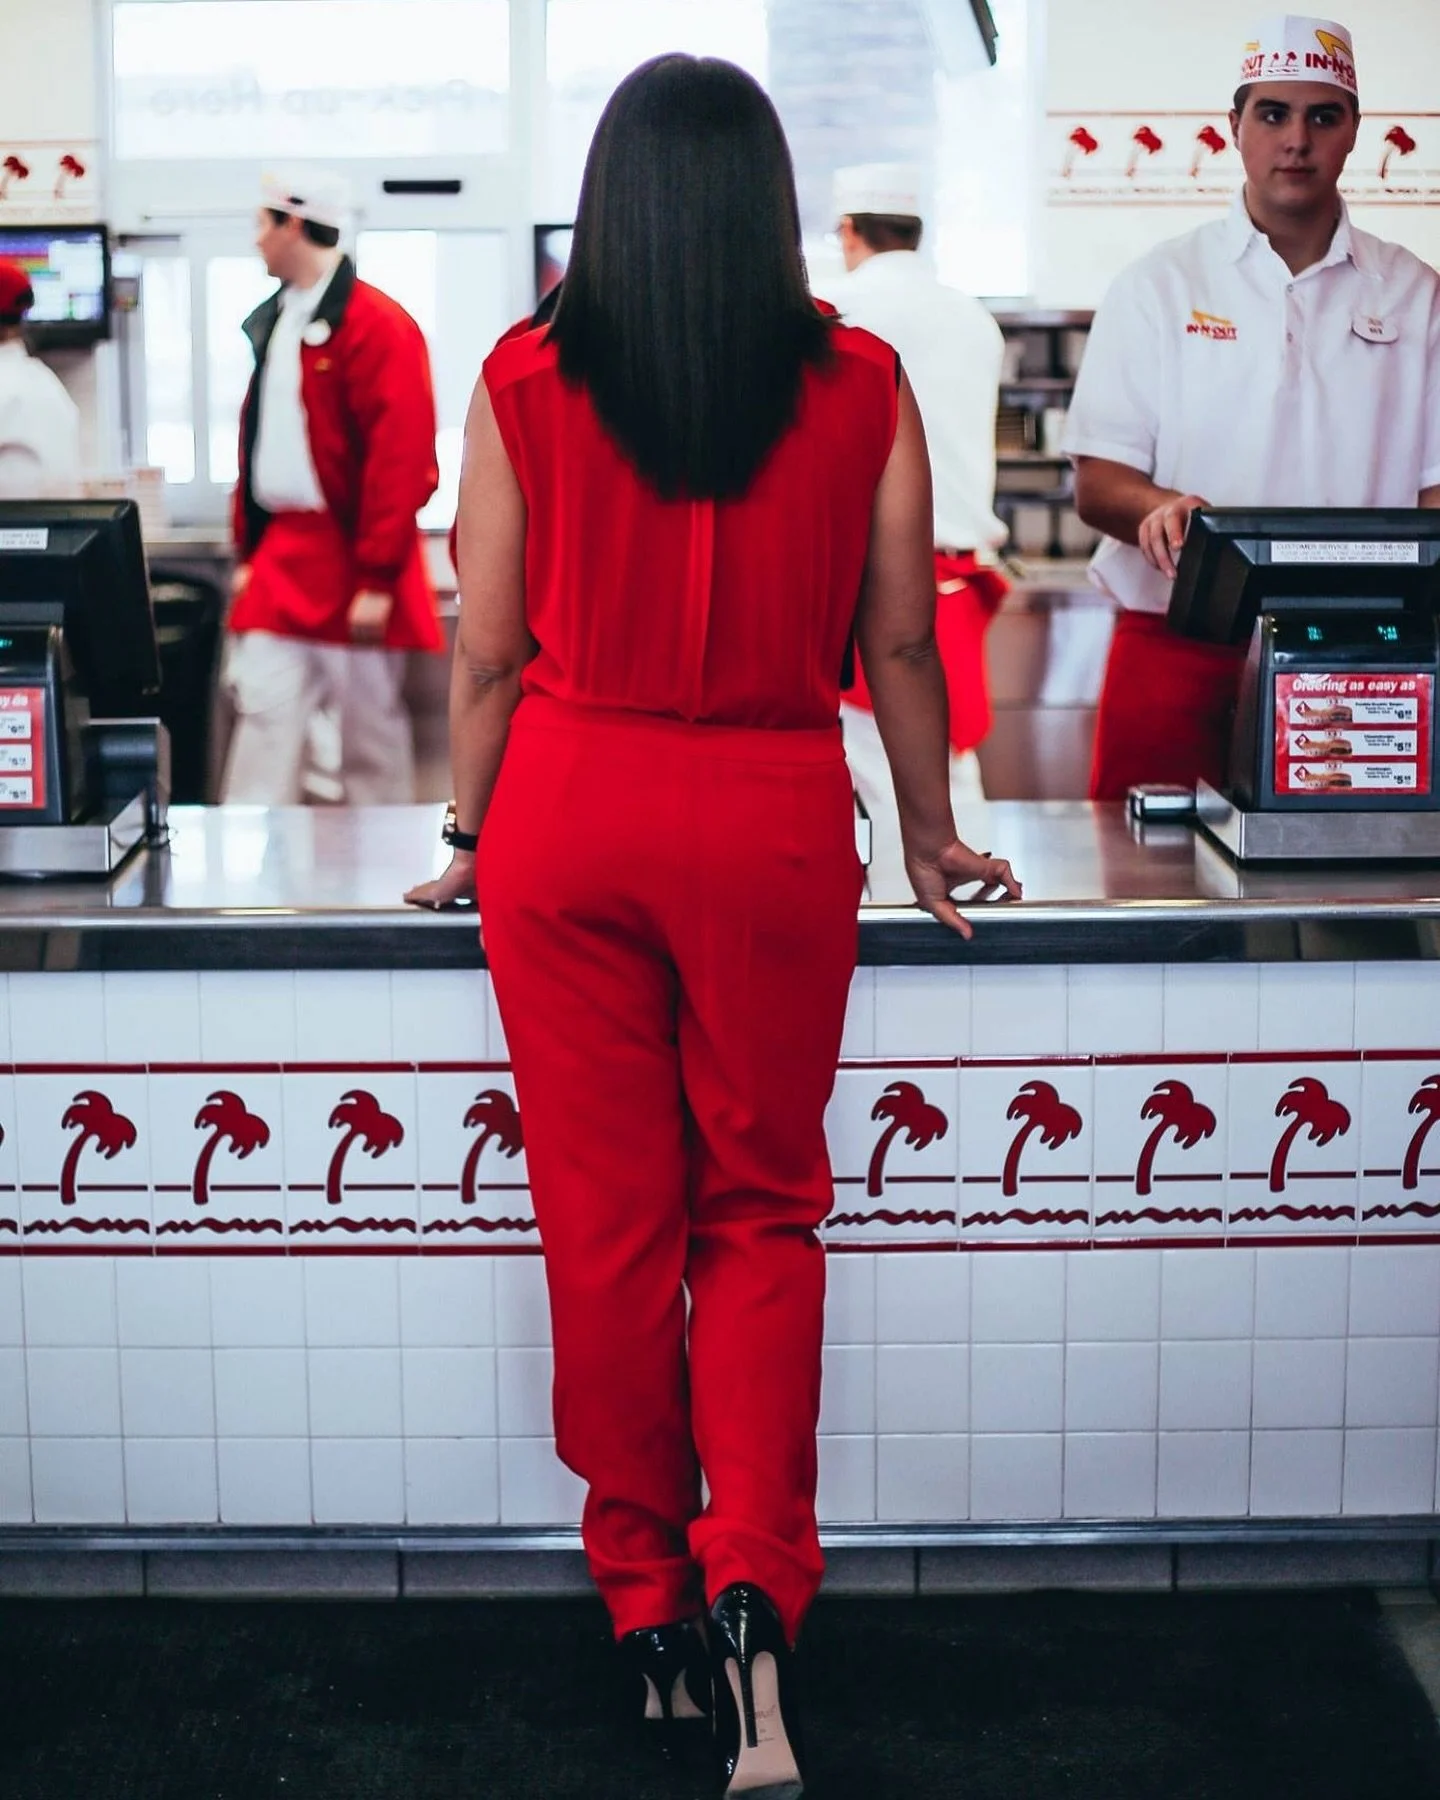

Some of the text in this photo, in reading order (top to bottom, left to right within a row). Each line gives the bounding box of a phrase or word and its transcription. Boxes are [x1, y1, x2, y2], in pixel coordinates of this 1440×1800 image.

[1292, 678, 1416, 693] Ordering as easy as
